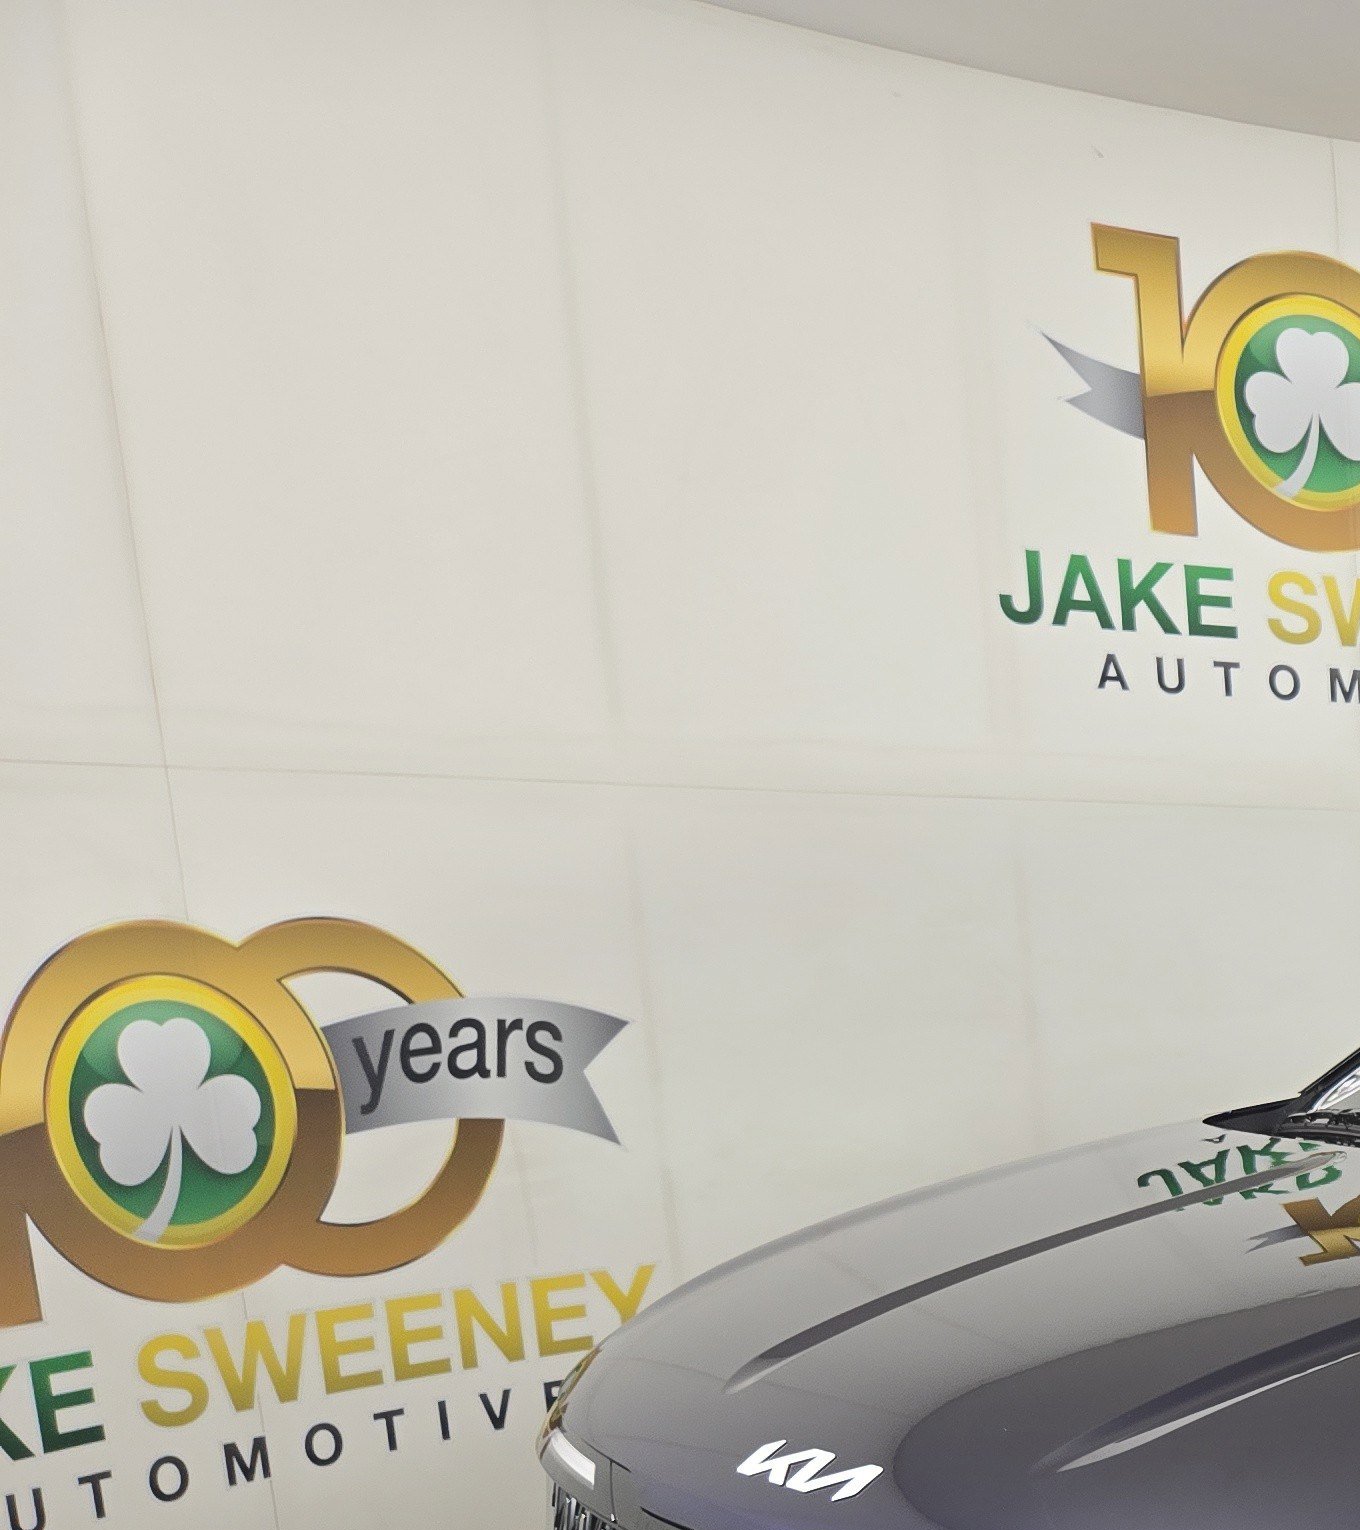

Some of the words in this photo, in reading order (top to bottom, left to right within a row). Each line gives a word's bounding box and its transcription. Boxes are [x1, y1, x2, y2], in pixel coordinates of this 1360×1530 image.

[998, 548, 1239, 640] JAKE
[352, 1016, 565, 1116] years
[136, 1263, 656, 1428] SWEENEY
